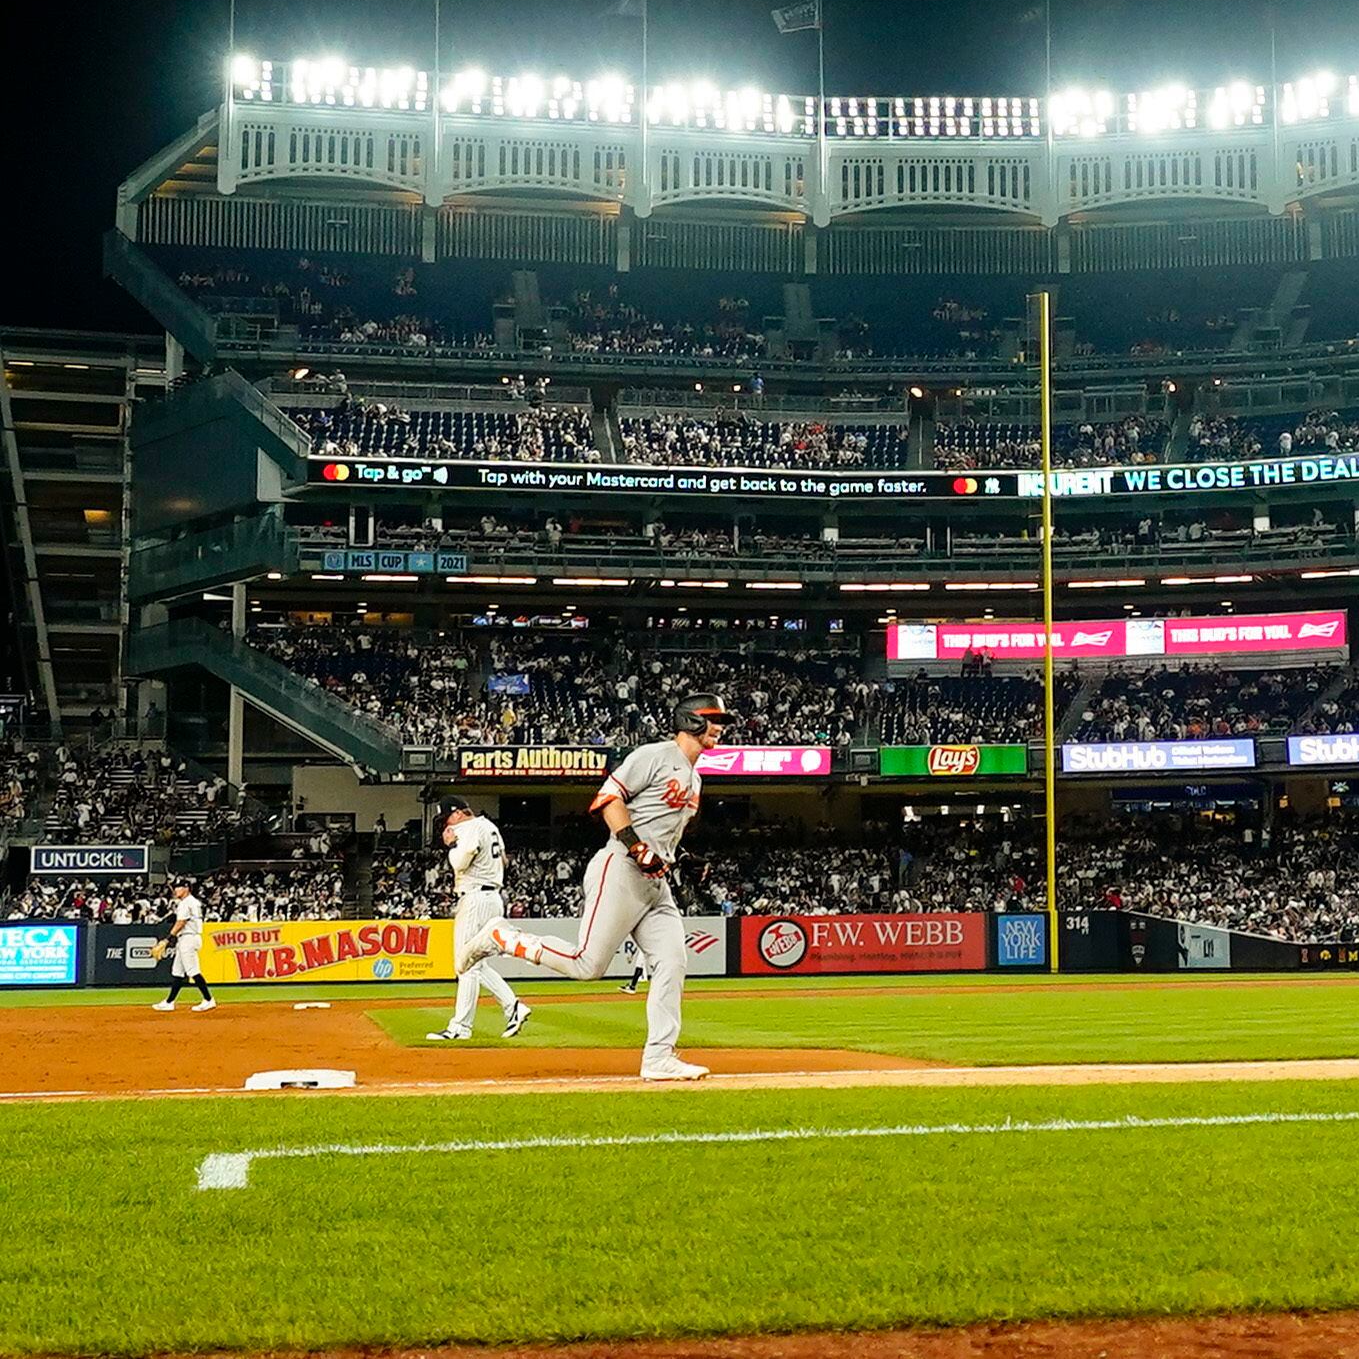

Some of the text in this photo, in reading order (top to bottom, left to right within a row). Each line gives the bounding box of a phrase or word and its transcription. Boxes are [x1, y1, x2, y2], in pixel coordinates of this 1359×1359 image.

[355, 465, 385, 482] Tap
[387, 466, 398, 480] &
[1124, 471, 1161, 491] WE
[1167, 467, 1245, 489] CLOSE
[1250, 463, 1295, 485] THE
[478, 469, 927, 496] Tap with your Mastercard and get back to the game faster.
[352, 553, 465, 570] MLS CUP 2021
[1036, 632, 1065, 647] YU.
[461, 747, 607, 770] Parts Authority
[1069, 747, 1167, 770] StubHub
[41, 852, 123, 868] UNTUCKit
[1006, 921, 1037, 935] NEW
[1066, 916, 1089, 930] 314
[213, 929, 281, 947] WHO BUT
[811, 921, 964, 947] F.W. WEBB
[1002, 932, 1040, 947] YORK
[22, 946, 70, 960] YORK
[106, 947, 124, 959] THE
[1006, 945, 1037, 959] LIFE
[375, 960, 392, 978] hp
[400, 962, 433, 970] Preferred
